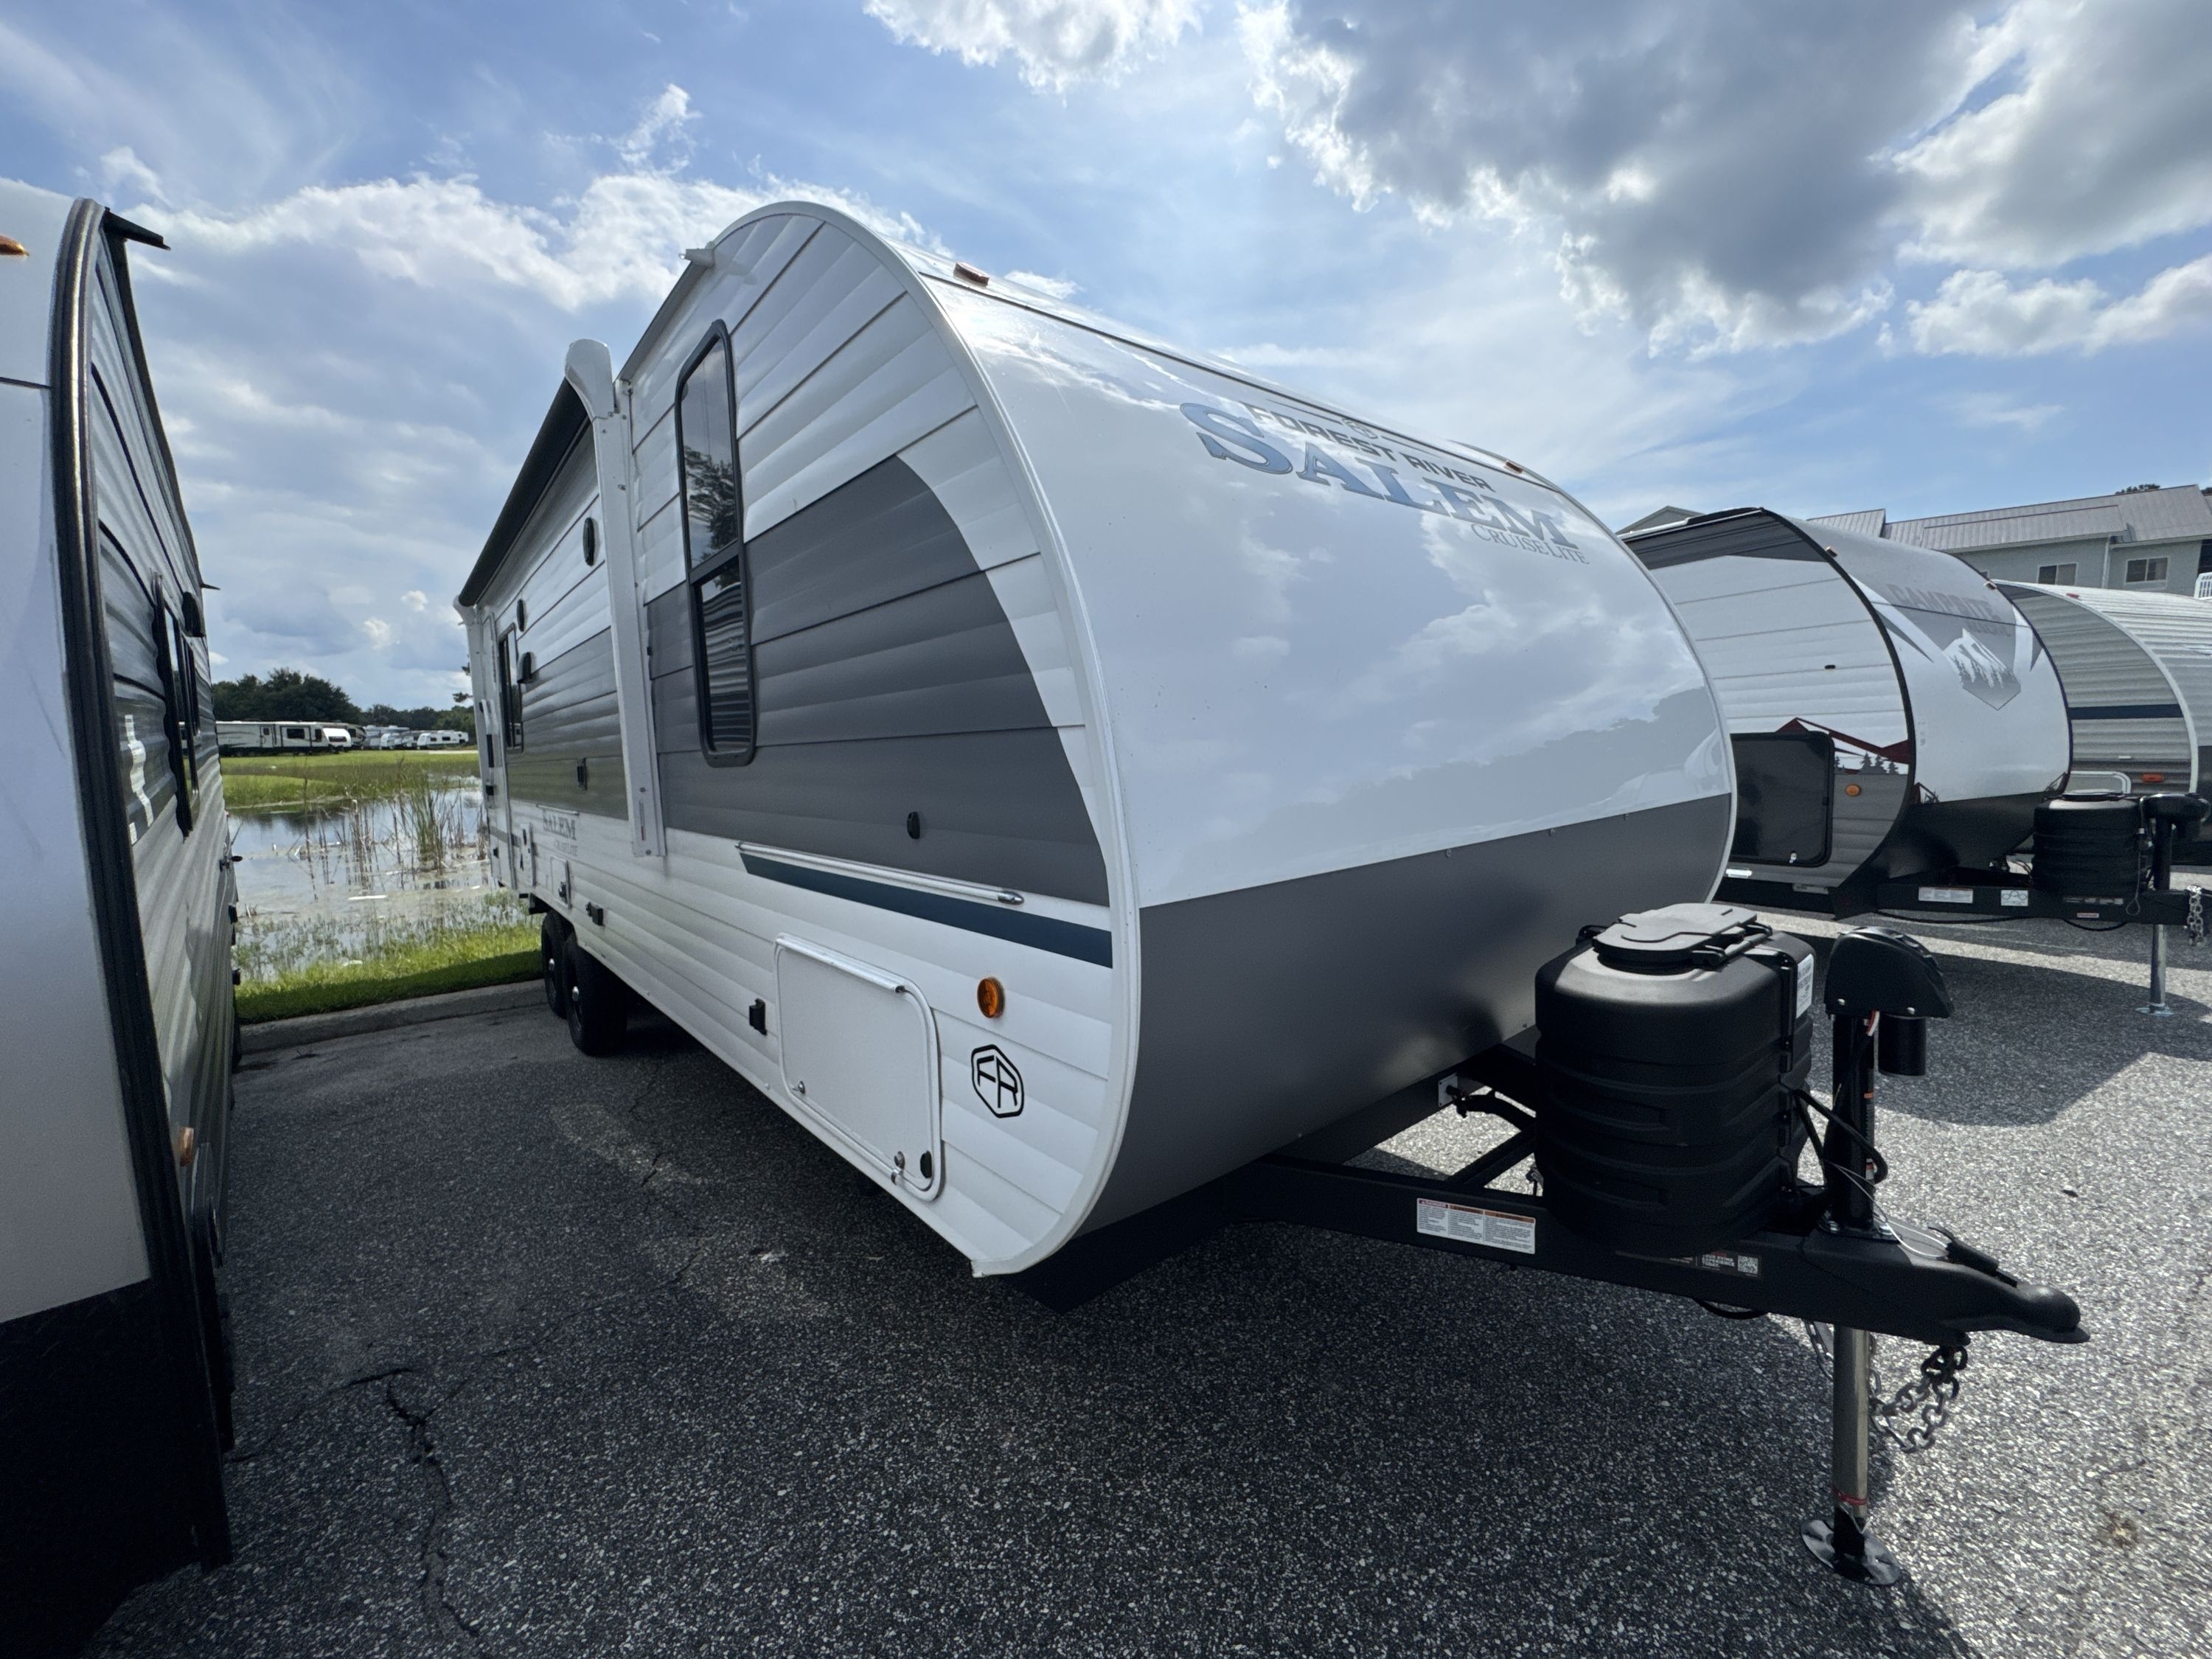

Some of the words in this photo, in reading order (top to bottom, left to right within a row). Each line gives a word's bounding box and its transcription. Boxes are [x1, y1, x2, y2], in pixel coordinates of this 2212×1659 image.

[1180, 403, 1579, 549] SALEM
[1239, 401, 1397, 462] FOREST
[1399, 451, 1496, 493] RIVER
[1885, 583, 2003, 622] CAMPSITE
